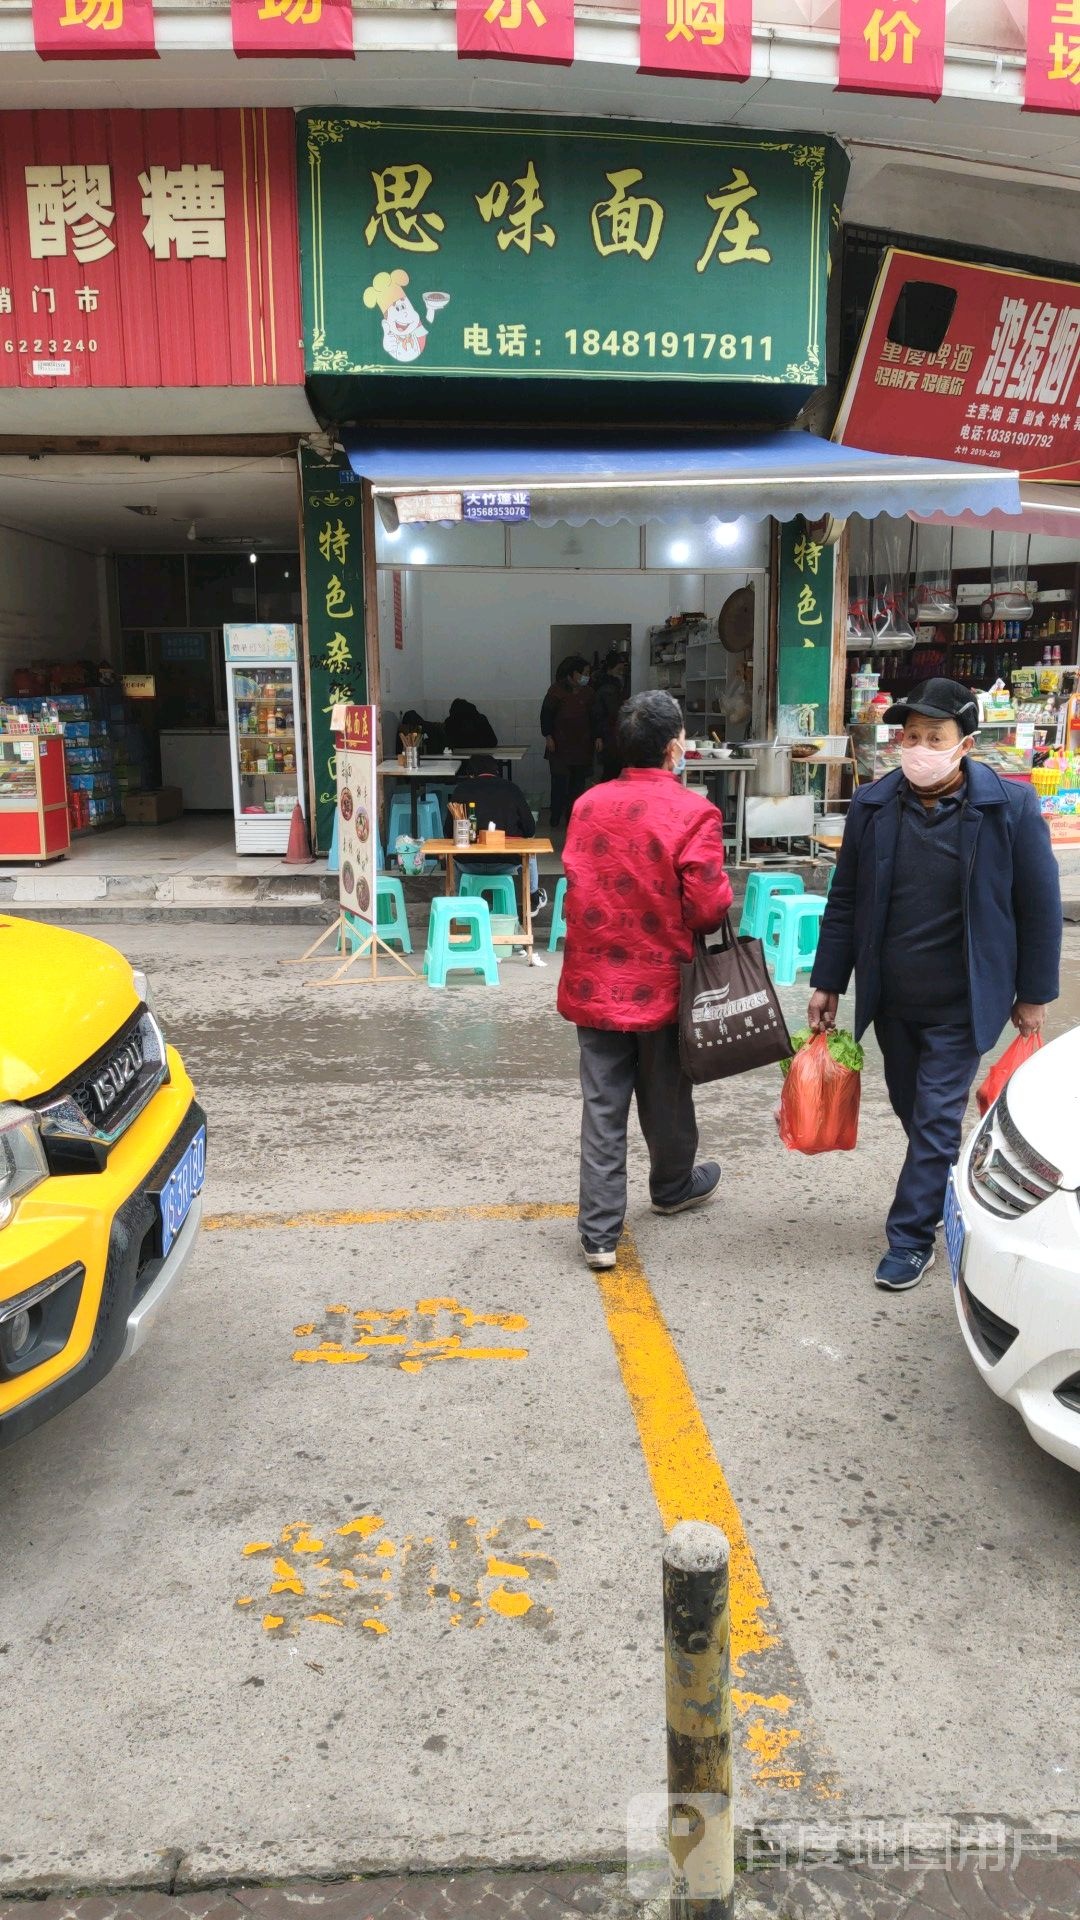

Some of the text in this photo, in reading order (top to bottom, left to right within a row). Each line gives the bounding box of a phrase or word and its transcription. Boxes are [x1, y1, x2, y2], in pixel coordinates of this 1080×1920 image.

[863, 0, 921, 64] 价
[24, 164, 228, 263] 醪糟
[364, 160, 771, 273] 思味面庄
[5, 339, 97, 353] 6223240
[564, 329, 773, 361] 18481917811
[466, 506, 526, 517] 13568353076
[92, 1042, 143, 1112] ISUZU
